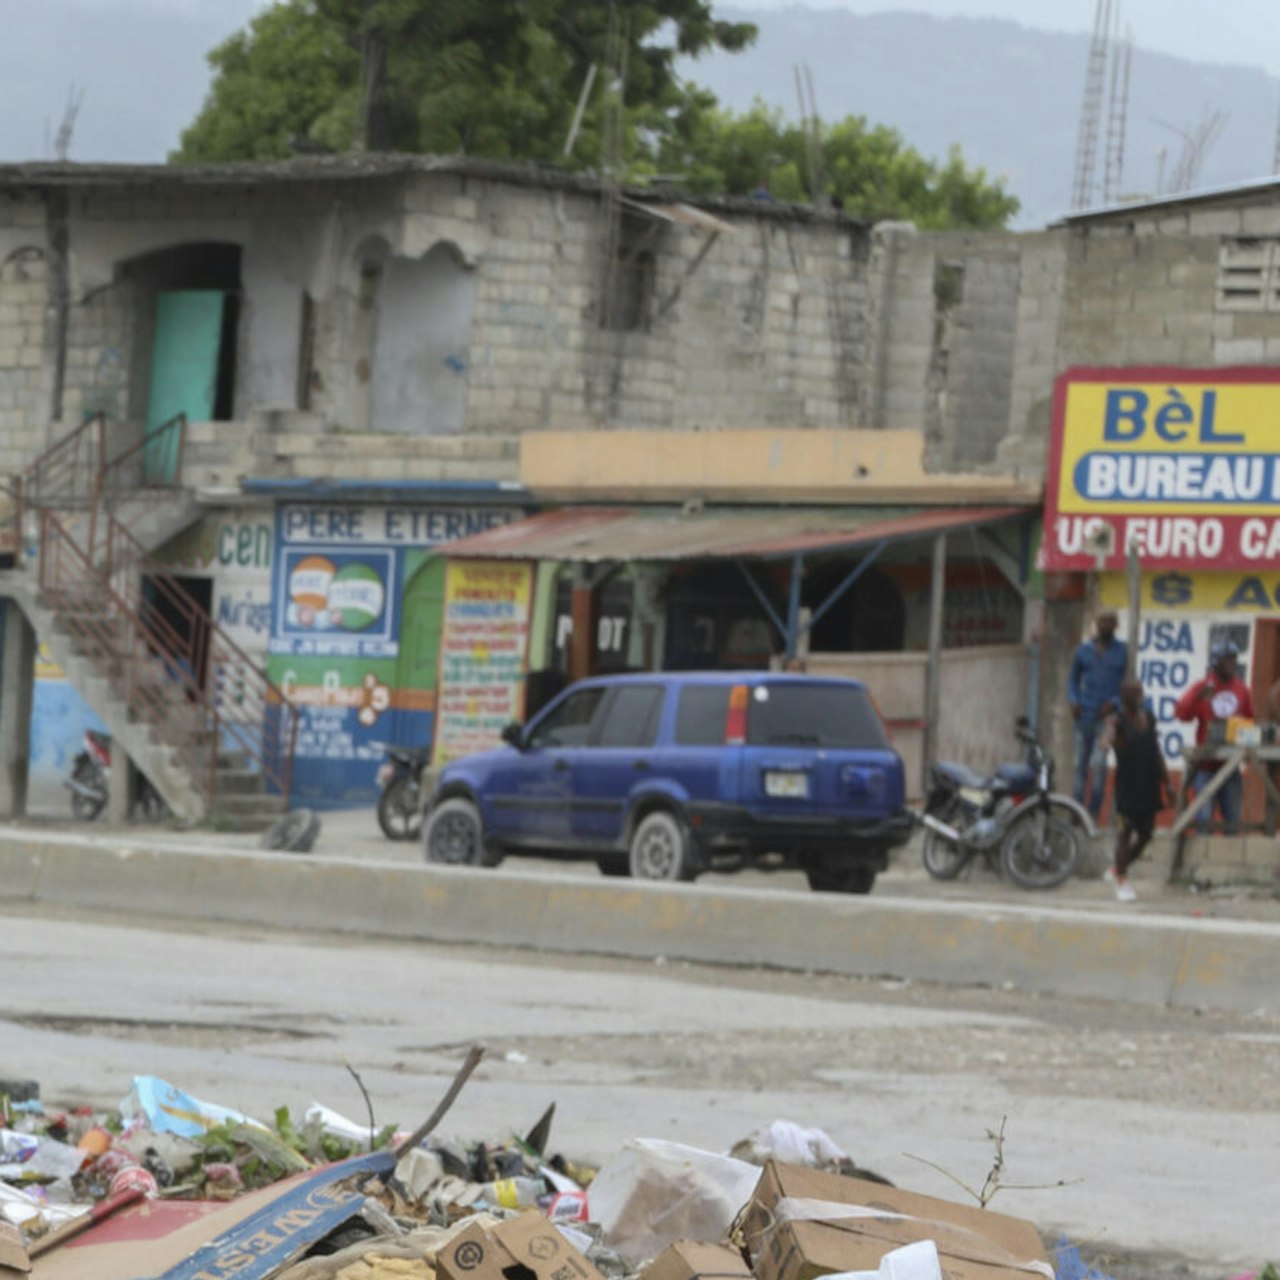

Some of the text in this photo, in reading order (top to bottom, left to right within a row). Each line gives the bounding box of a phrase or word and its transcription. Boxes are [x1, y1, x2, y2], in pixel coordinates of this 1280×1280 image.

[1102, 384, 1246, 443] BèL
[1086, 454, 1266, 500] BUREAU
[286, 510, 363, 540] PERE
[1124, 518, 1224, 559] EURO
[1226, 575, 1280, 609] A
[1140, 660, 1190, 688] RO
